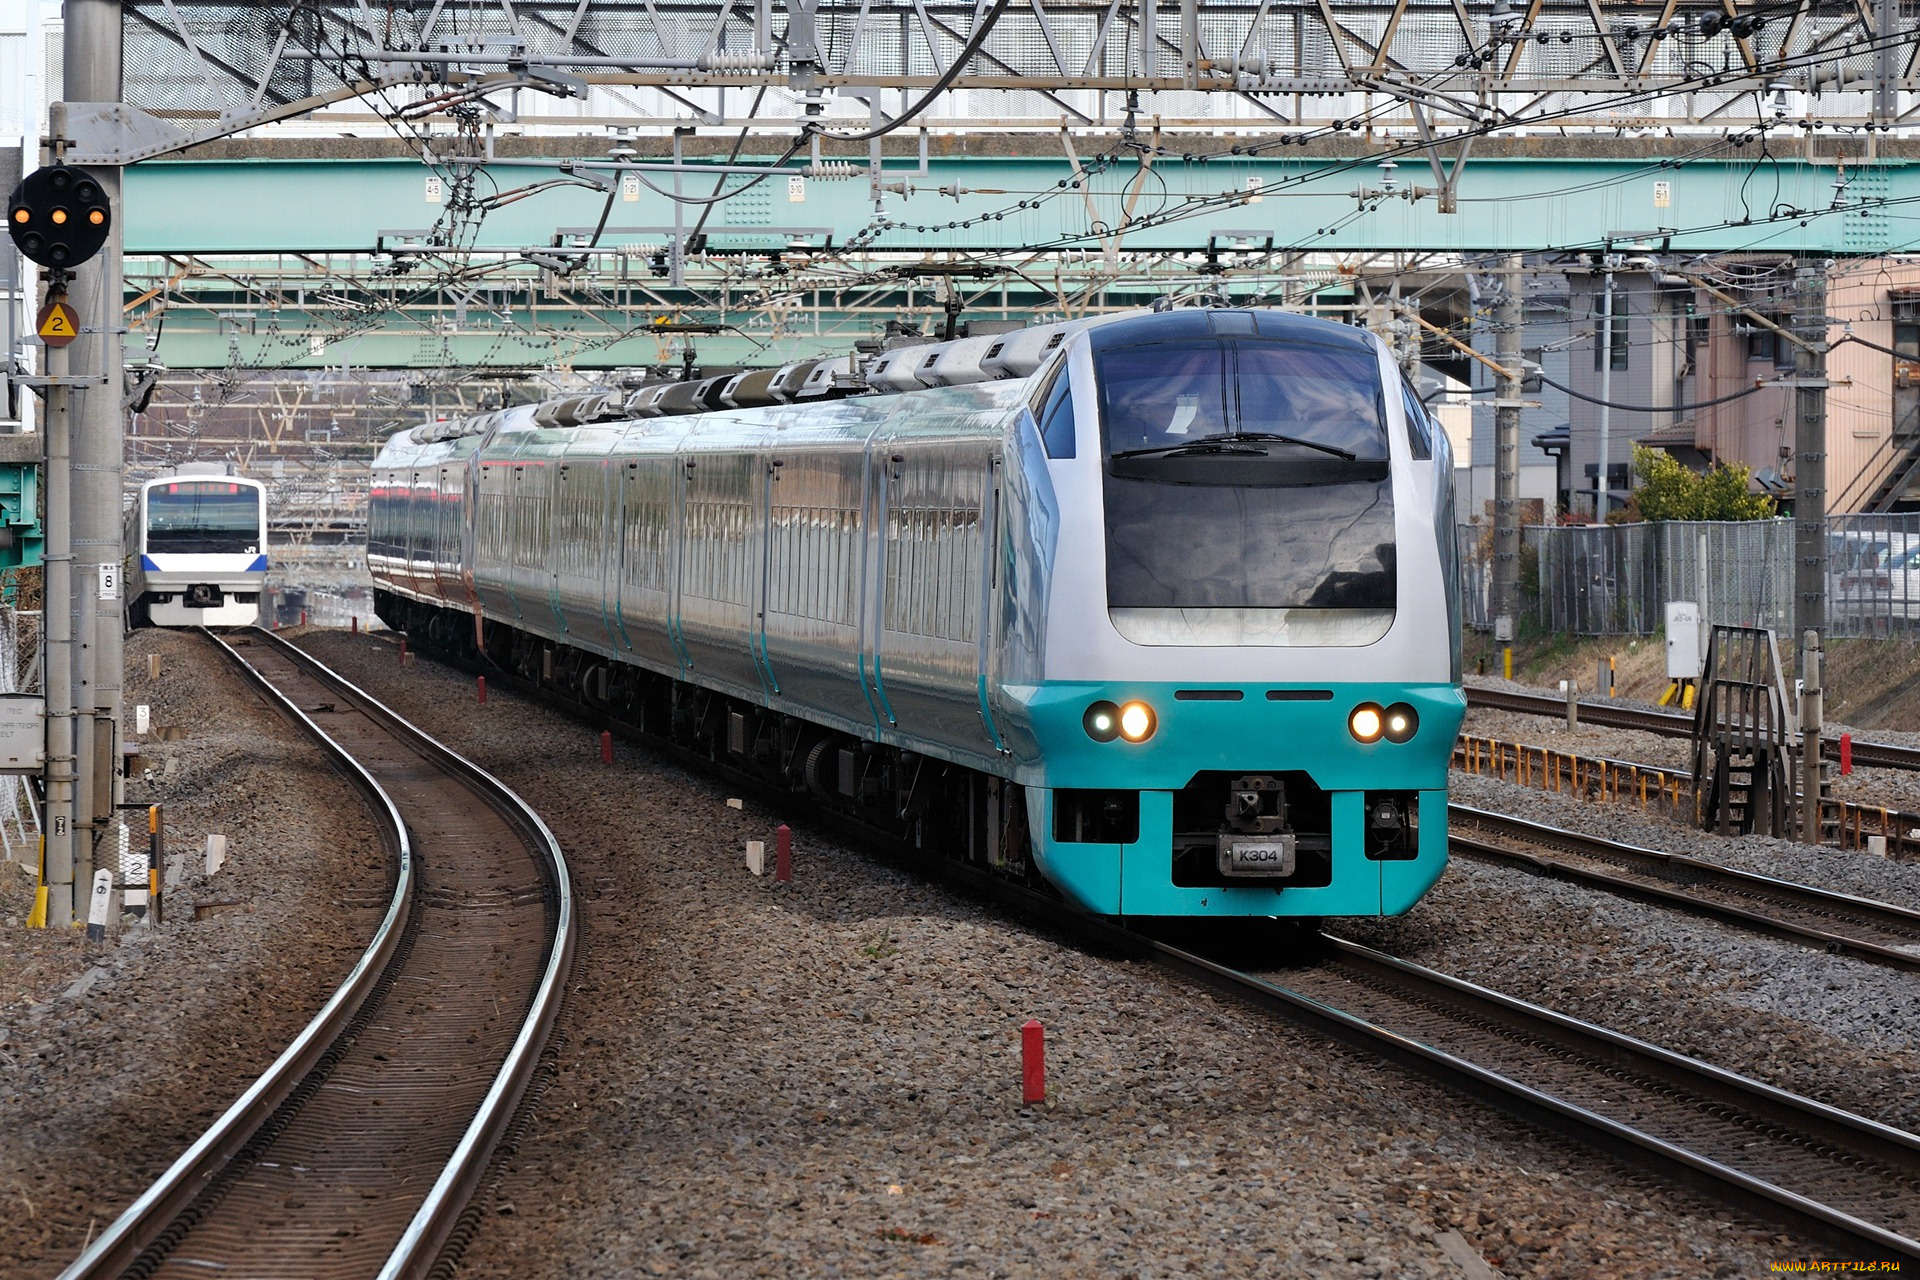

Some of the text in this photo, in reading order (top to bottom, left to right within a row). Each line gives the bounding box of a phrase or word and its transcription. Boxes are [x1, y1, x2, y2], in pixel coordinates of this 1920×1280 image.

[52, 317, 63, 331] 2
[244, 546, 257, 554] JR
[105, 575, 112, 588] 8
[139, 707, 147, 718] 3
[1240, 850, 1278, 862] K304
[130, 863, 142, 875] 2
